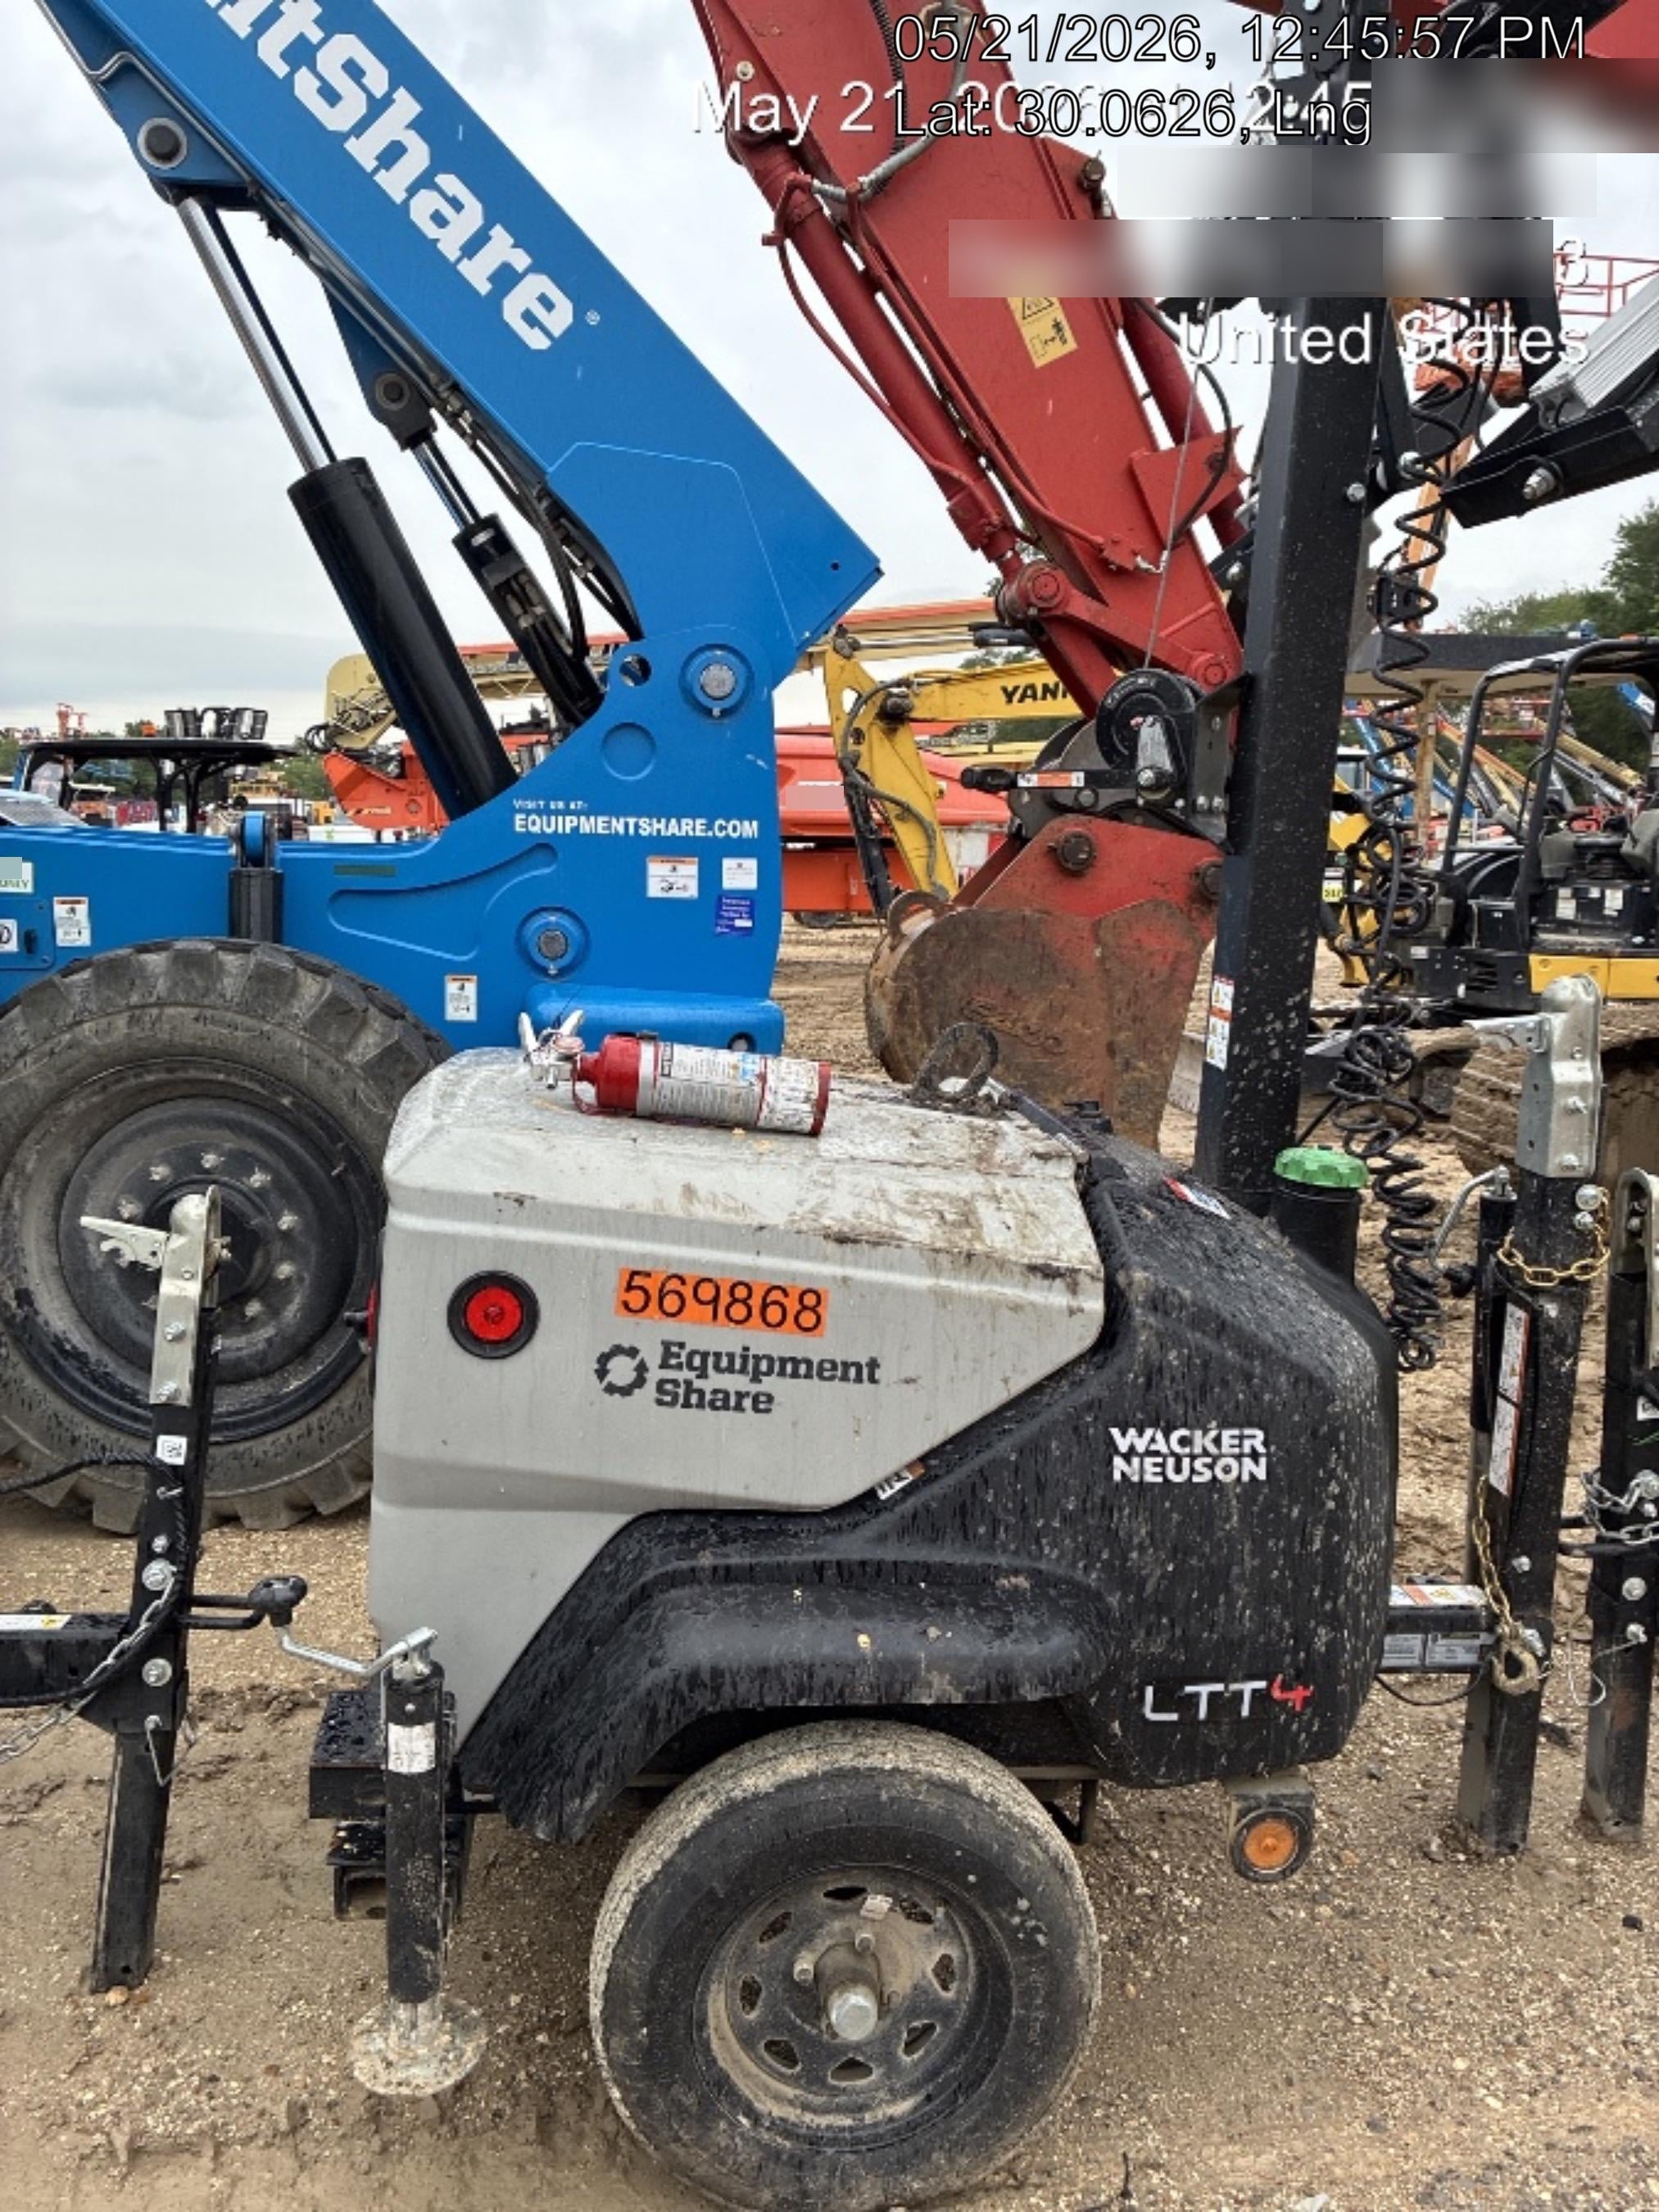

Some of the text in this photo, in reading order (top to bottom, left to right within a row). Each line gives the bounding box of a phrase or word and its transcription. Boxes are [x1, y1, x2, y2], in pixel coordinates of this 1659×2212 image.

[514, 814, 759, 840] EQUIPMENTSHARE.COM
[620, 1269, 823, 1334] 569868
[658, 1339, 881, 1386] Equipment
[655, 1377, 776, 1415] Share
[1108, 1426, 1267, 1455] WACKER
[1112, 1456, 1267, 1484] NEUSON
[1144, 1672, 1314, 1722] LTT4
